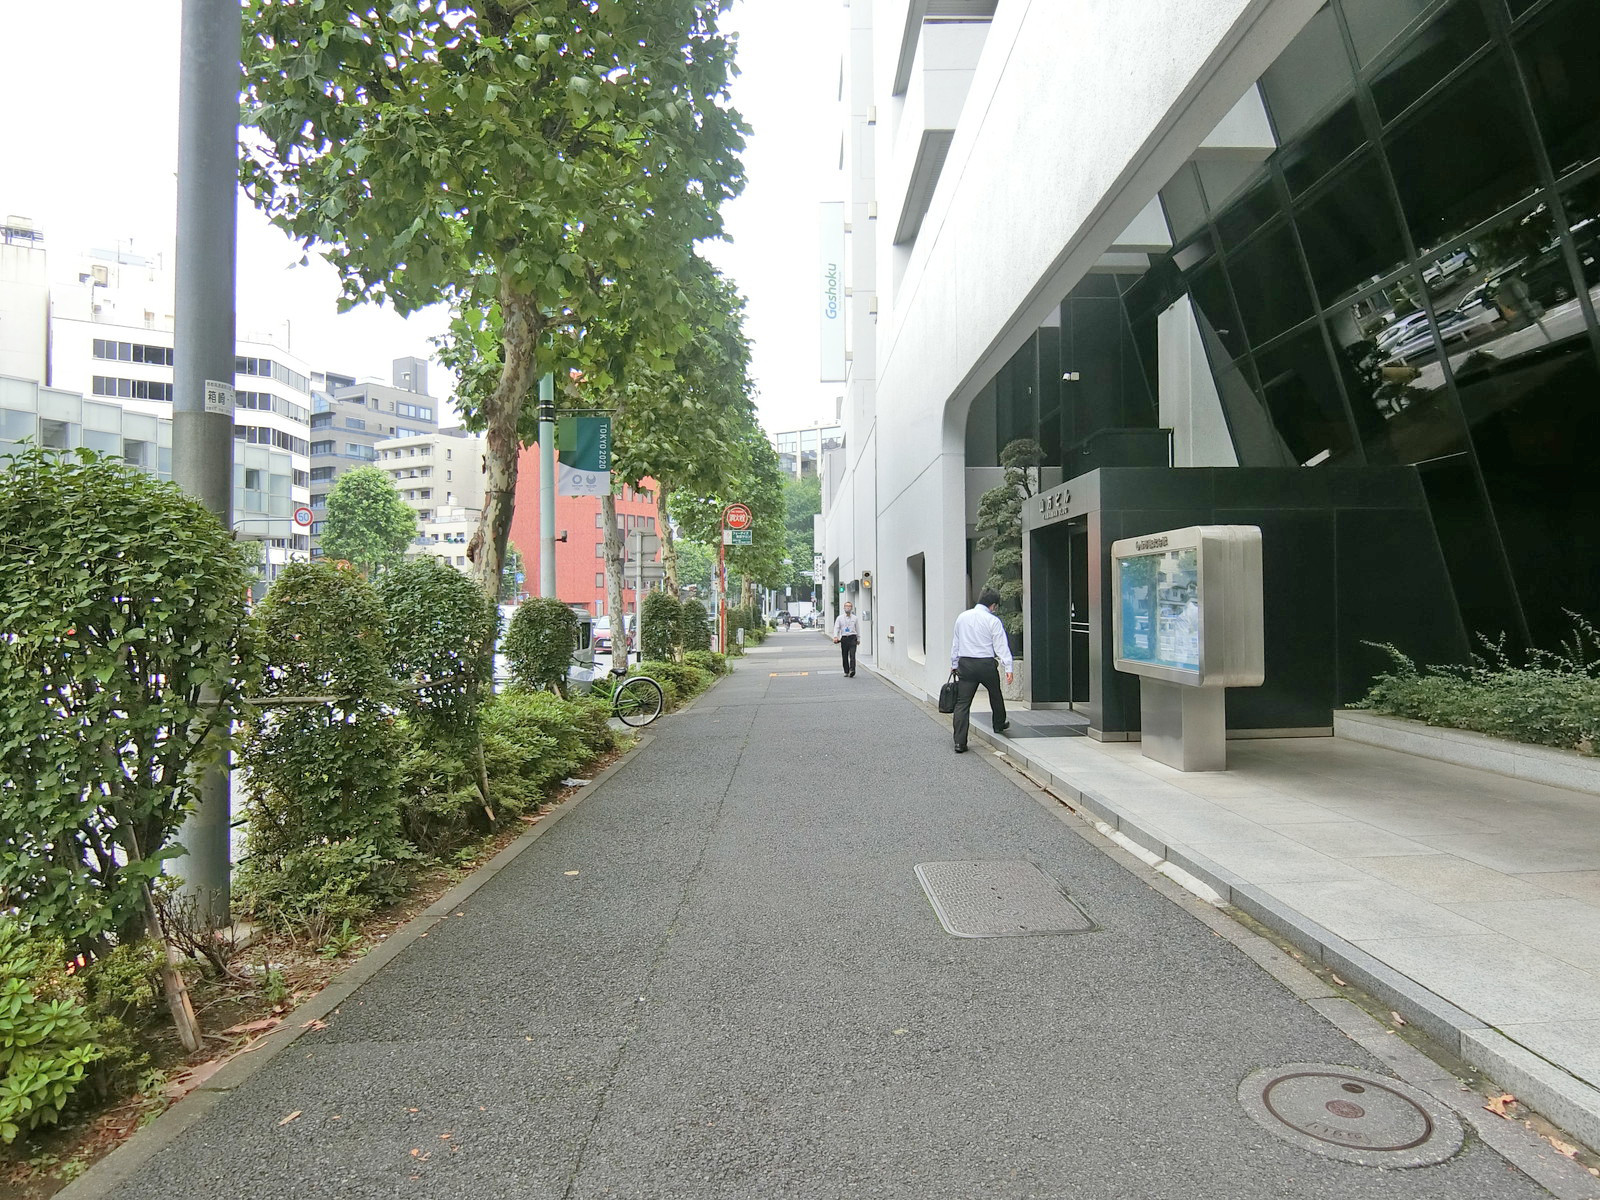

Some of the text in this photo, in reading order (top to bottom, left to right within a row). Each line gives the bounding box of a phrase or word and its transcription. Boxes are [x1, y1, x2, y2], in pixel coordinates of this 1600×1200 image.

[825, 263, 837, 320] Goshoku
[598, 423, 608, 469] TOKYO 2020
[298, 512, 310, 522] 50
